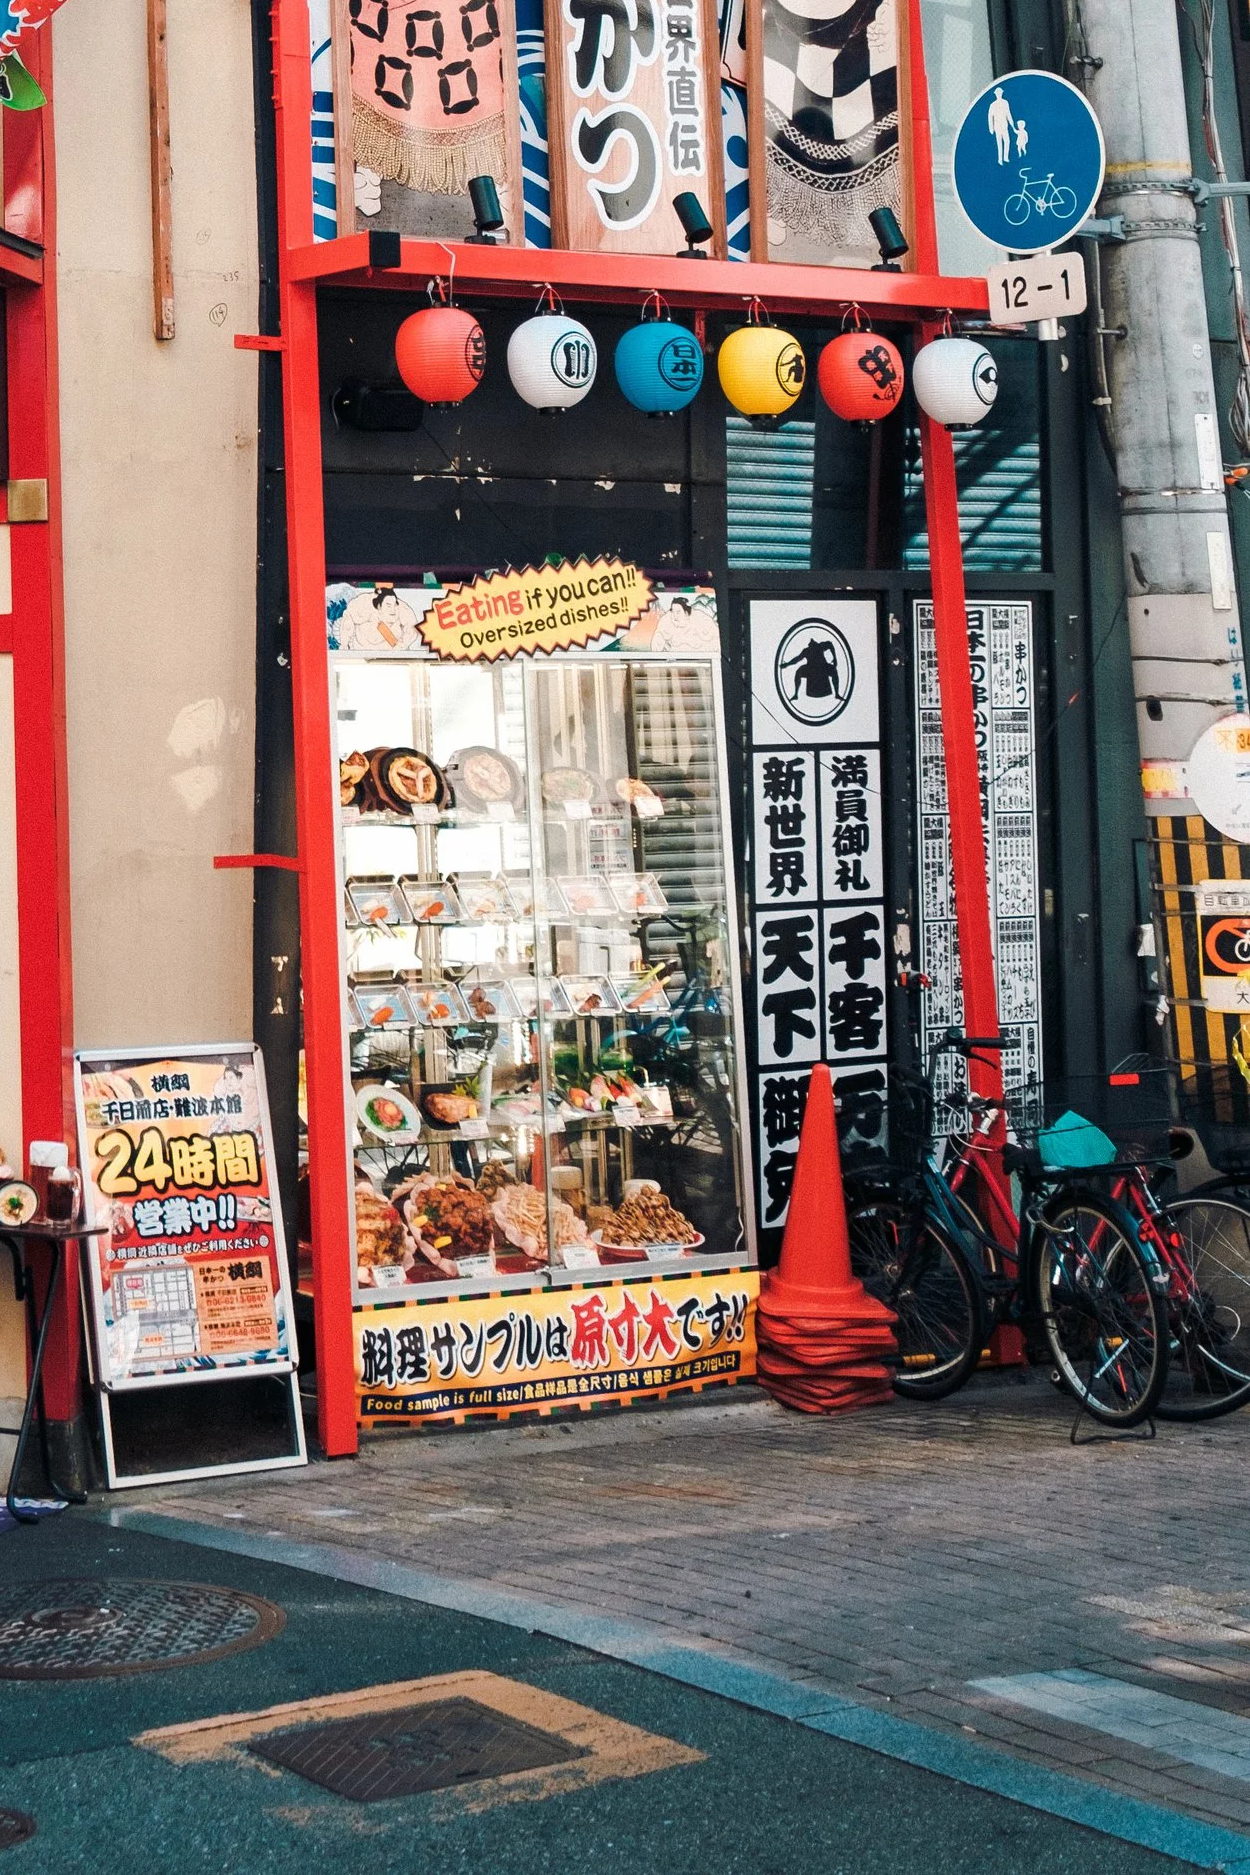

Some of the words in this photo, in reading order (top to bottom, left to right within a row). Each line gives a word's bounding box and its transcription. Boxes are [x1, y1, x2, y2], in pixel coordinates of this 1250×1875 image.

[436, 589, 524, 631] Eating
[526, 587, 544, 612] if
[545, 579, 587, 611] you
[587, 568, 637, 599] can!!
[460, 614, 558, 650] Oversized
[560, 596, 630, 627] dishes!!
[1014, 640, 1028, 706] 串かつ
[762, 755, 808, 899] 新世界
[831, 754, 871, 894] 満員御礼
[760, 912, 818, 1060] 天下
[827, 910, 884, 1053] 千客
[101, 1096, 243, 1125] 千日前店・難波本館
[150, 1072, 191, 1094] 横綱
[95, 1128, 262, 1198] 24時間
[132, 1193, 238, 1237] 営業中!!
[228, 1260, 263, 1282] 横綱
[360, 1288, 749, 1390] 料理サンプルは原寸大です!!
[366, 1397, 403, 1412] Food
[407, 1394, 451, 1413] sample
[453, 1392, 465, 1406] is
[468, 1388, 493, 1404] full
